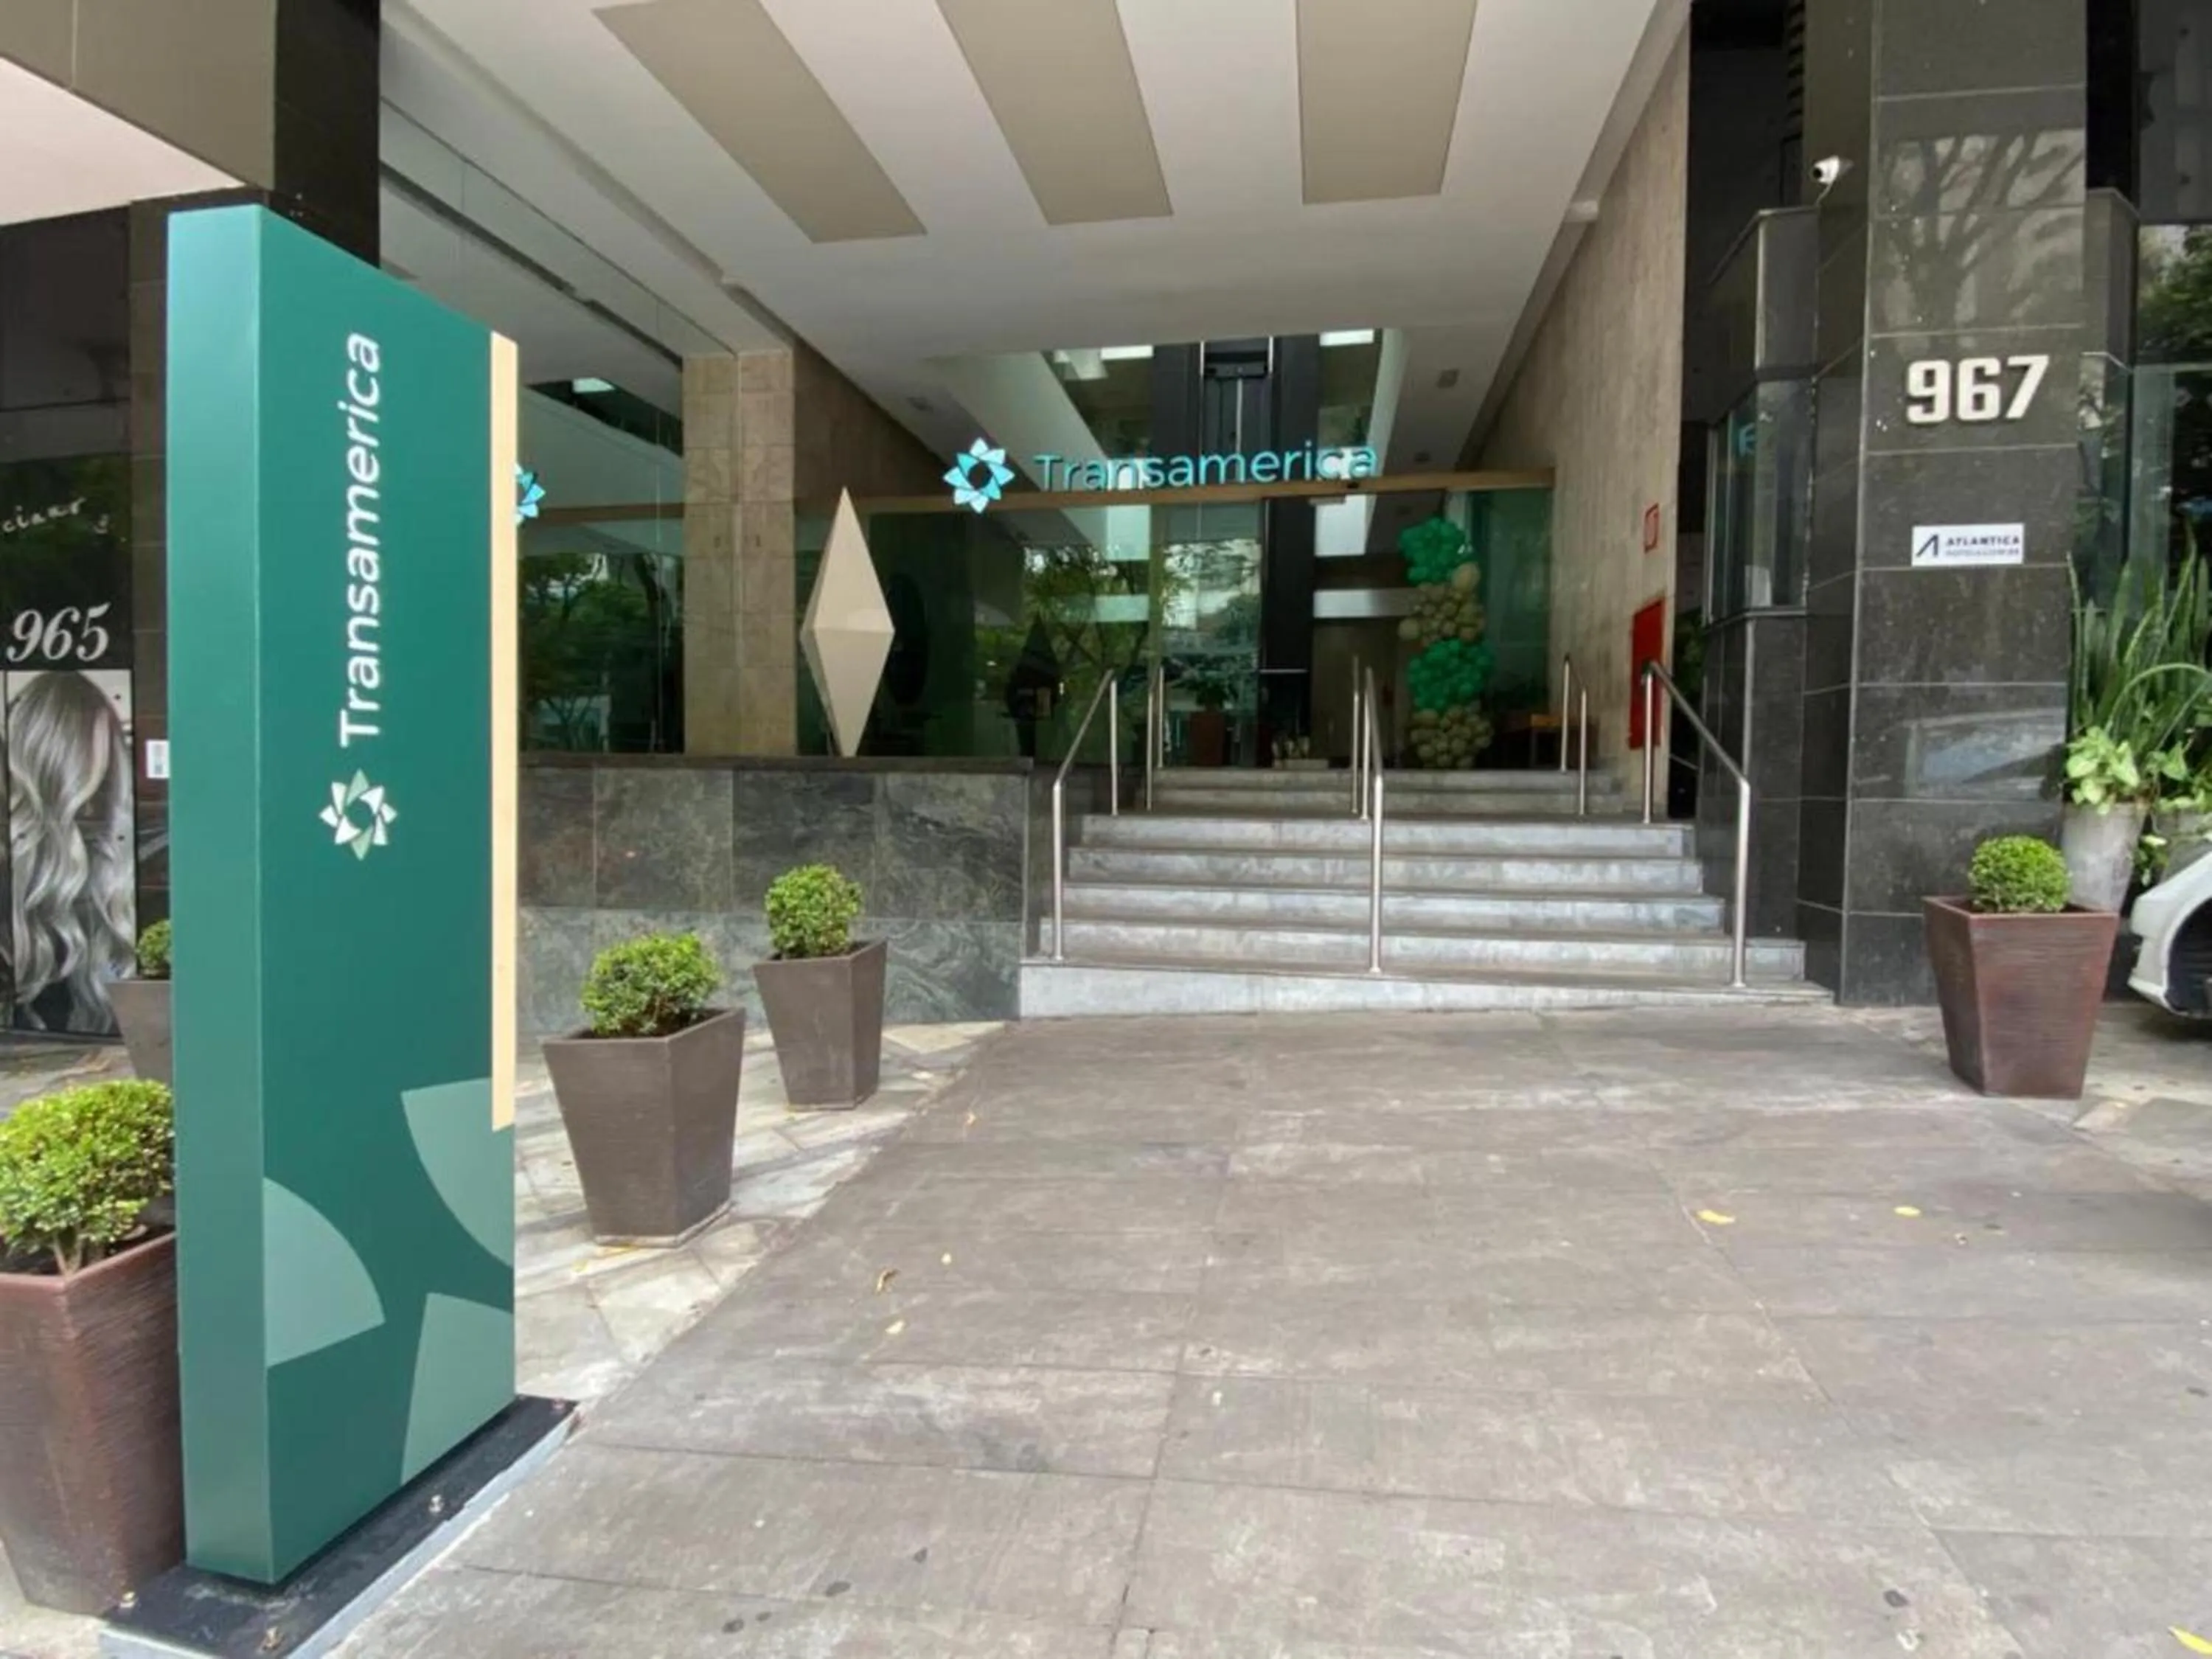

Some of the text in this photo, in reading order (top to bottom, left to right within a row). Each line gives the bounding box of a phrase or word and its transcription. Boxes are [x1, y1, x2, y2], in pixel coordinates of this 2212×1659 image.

[1905, 354, 2050, 424] 967
[1033, 439, 1377, 492] Transamerica
[337, 332, 382, 748] Transamerica
[6, 602, 111, 662] 965
